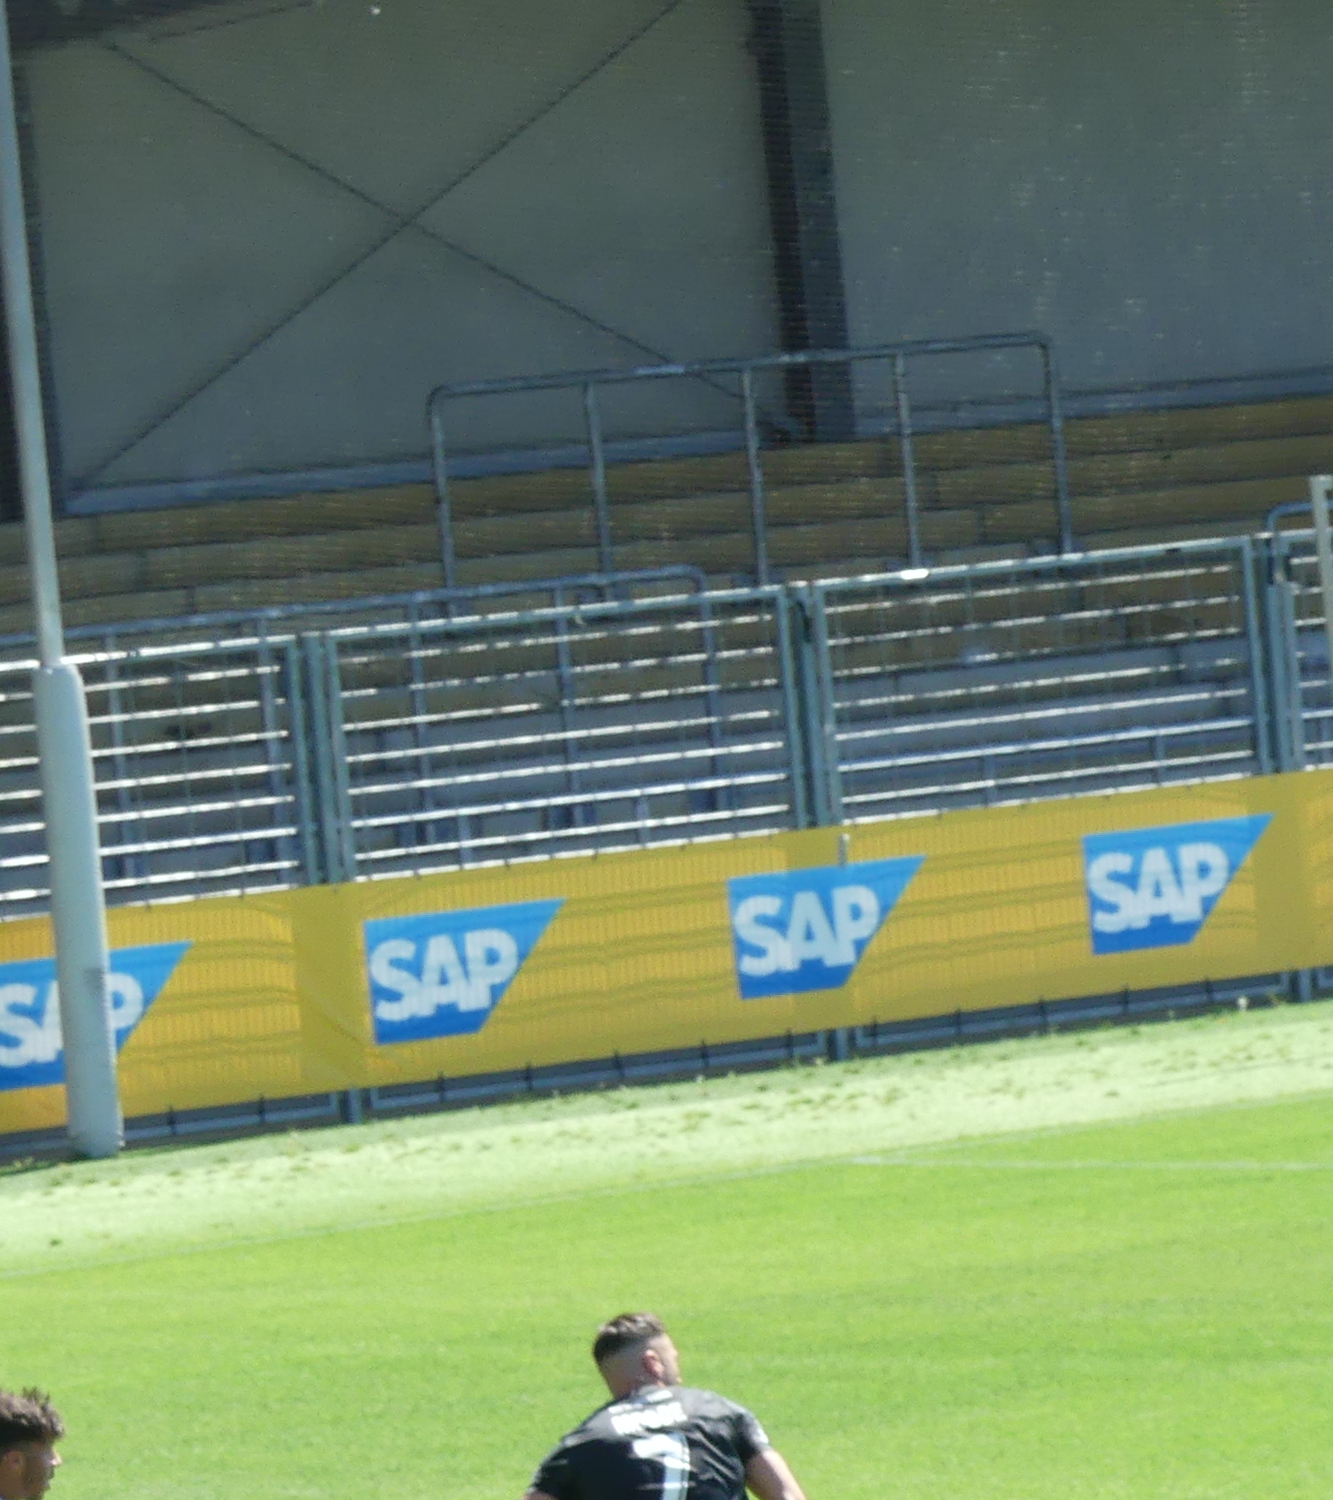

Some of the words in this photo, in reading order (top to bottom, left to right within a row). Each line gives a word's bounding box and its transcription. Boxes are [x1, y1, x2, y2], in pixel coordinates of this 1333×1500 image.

[735, 885, 880, 977] SAP
[1089, 841, 1230, 934] SAP
[371, 928, 518, 1022] SAP
